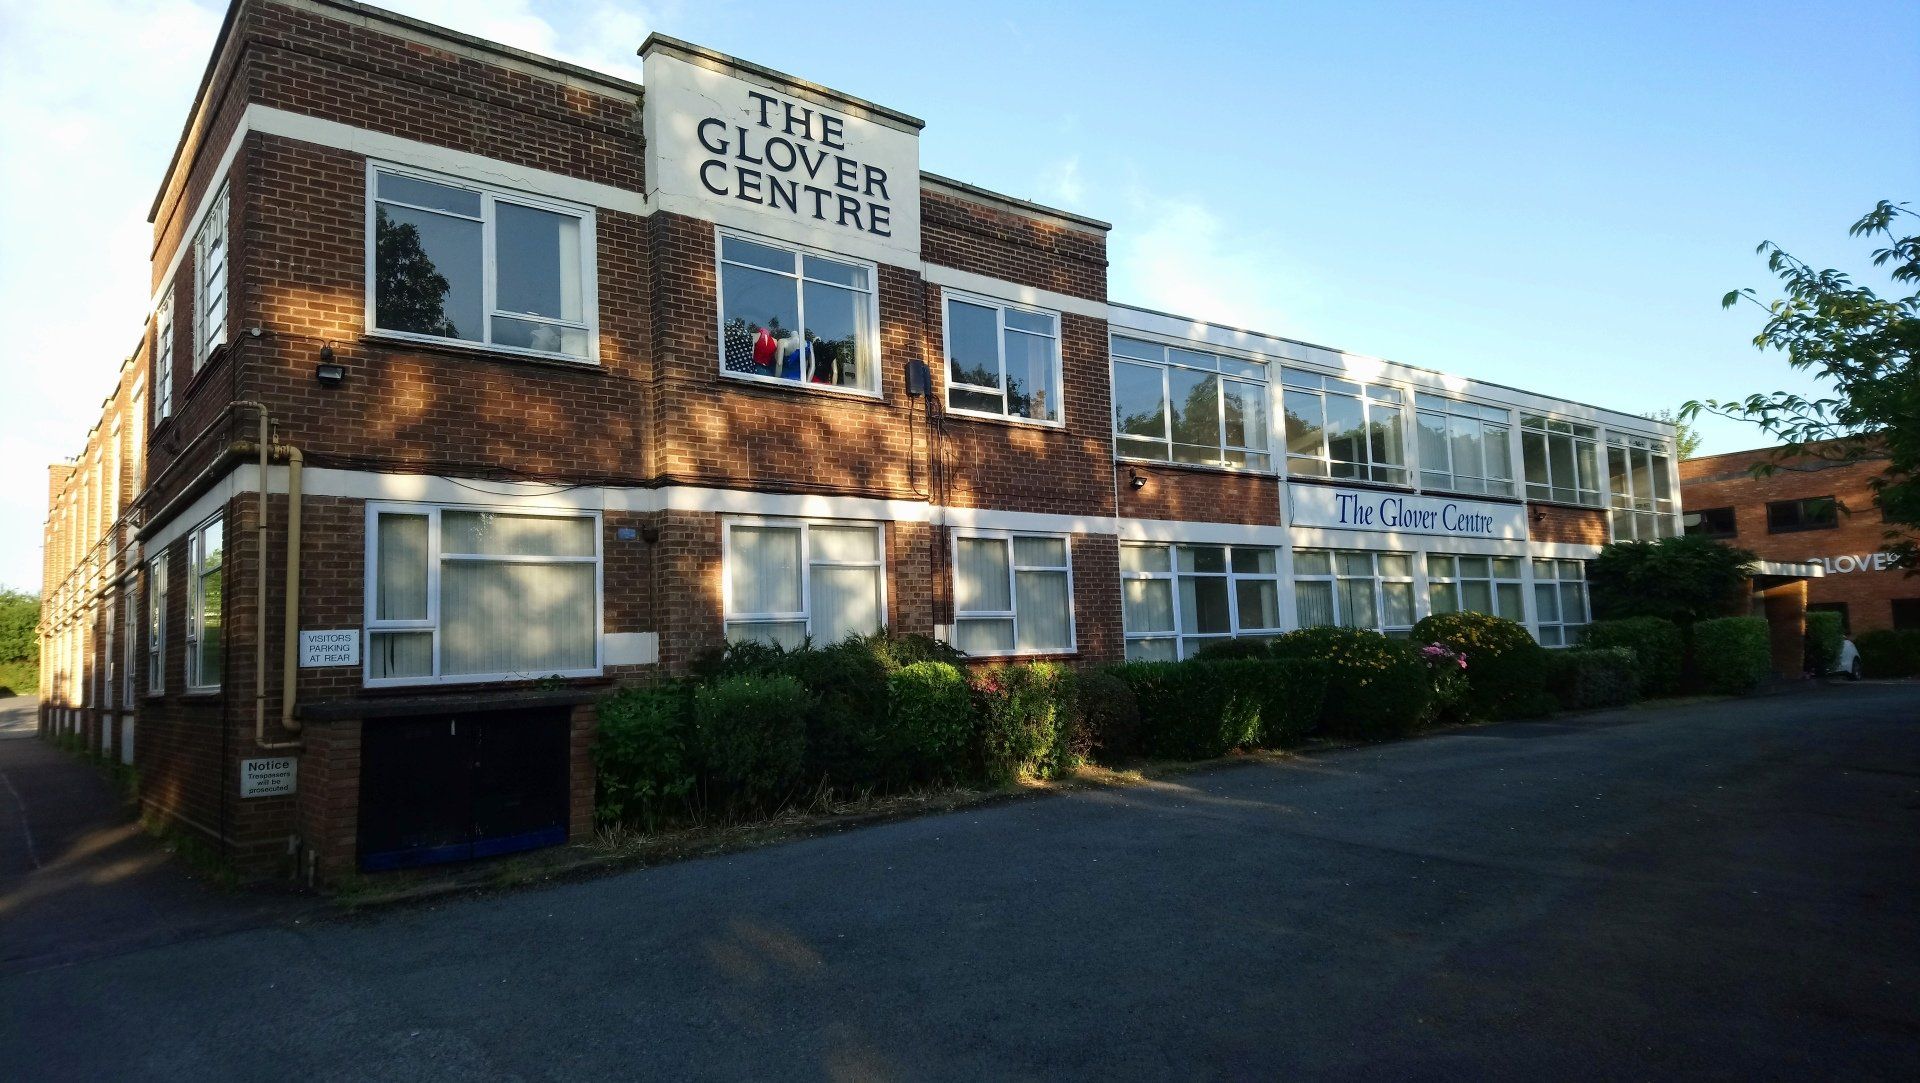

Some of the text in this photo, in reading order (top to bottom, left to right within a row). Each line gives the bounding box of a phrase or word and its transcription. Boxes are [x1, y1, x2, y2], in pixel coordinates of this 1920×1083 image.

[749, 91, 845, 150] THE
[697, 117, 890, 200] GLOVER
[700, 159, 892, 237] CENTRE
[1336, 493, 1493, 534] The Glover Centre
[309, 634, 351, 643] VISITORS
[309, 644, 350, 652] PARKING
[310, 654, 350, 662] AT REAR
[249, 760, 289, 771] Notice
[249, 785, 289, 794] prosecuted
